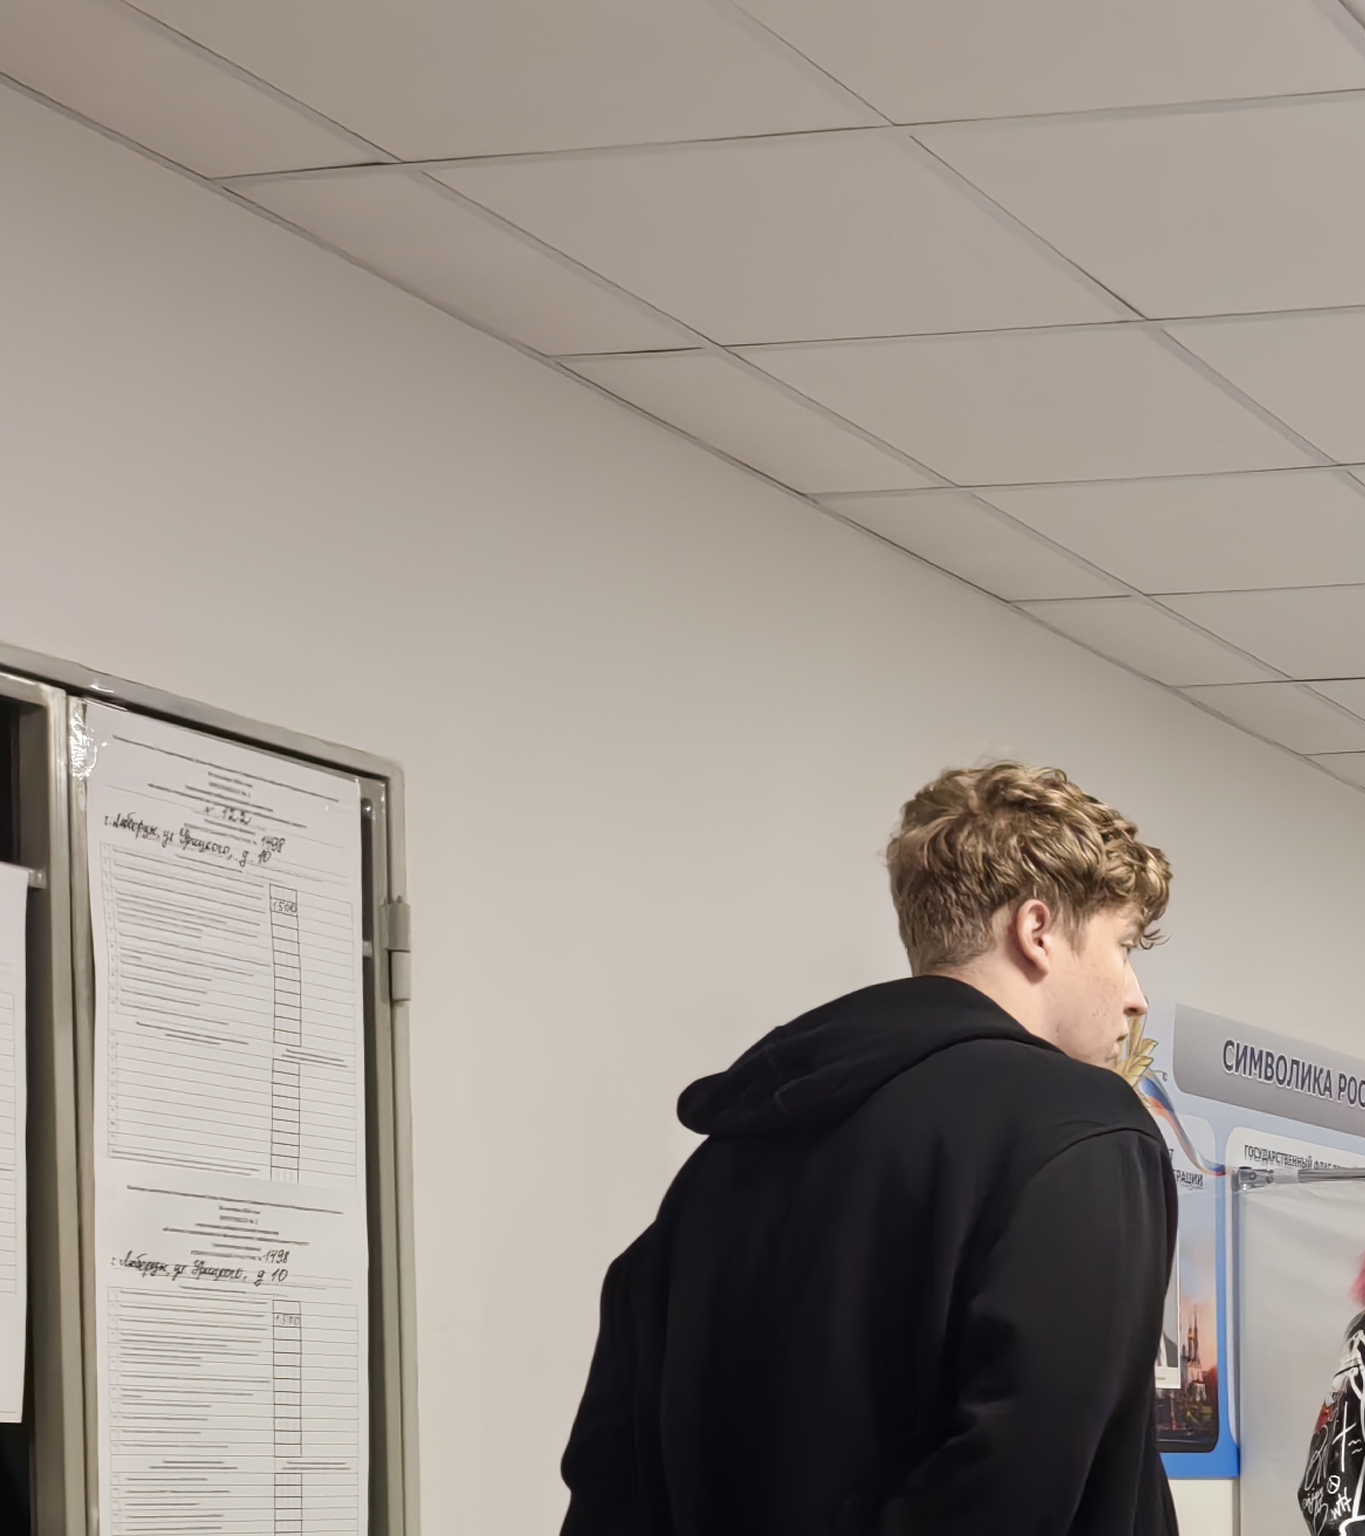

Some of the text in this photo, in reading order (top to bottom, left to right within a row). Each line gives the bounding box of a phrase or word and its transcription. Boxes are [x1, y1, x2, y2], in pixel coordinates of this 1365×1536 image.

[1223, 1039, 1333, 1099] СИМВОЛИКА
[1244, 1144, 1313, 1169] ГОСУДАРСТВЕННЫЙ
[270, 1266, 289, 1282] 10
